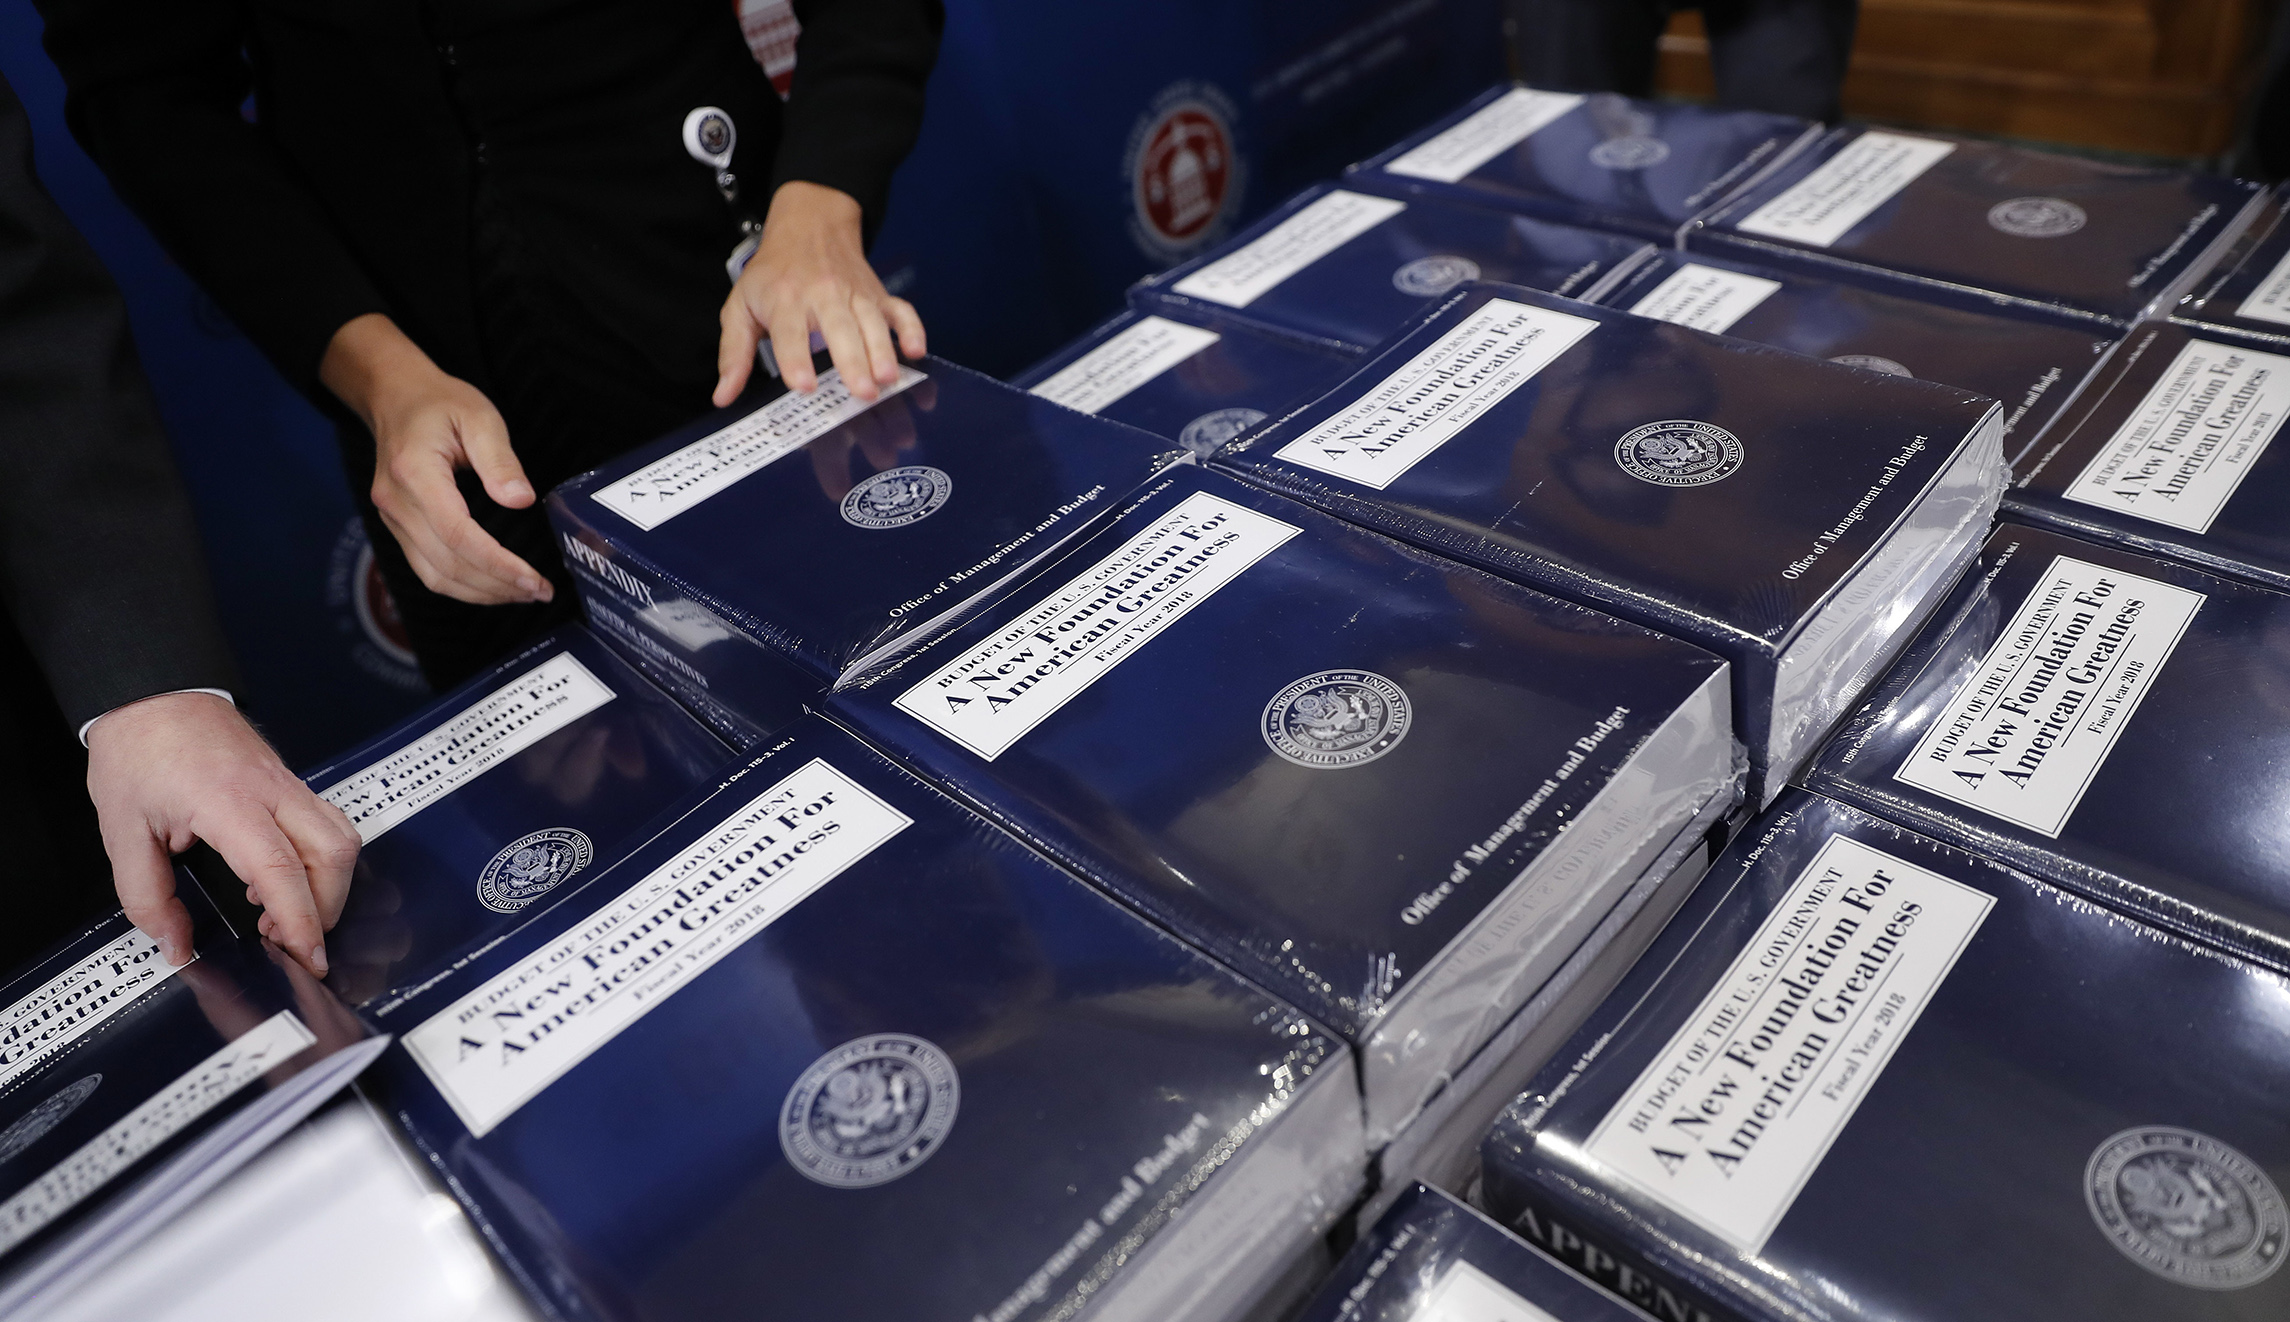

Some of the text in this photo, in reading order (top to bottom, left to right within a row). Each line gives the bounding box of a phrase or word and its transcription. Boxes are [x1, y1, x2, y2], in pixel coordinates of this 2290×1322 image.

[1321, 313, 1528, 461] A New Foundation For
[1360, 327, 1546, 460] American Greatness
[1693, 423, 1727, 442] UNITED
[1723, 439, 1738, 463] STATES
[629, 491, 648, 503] A
[1626, 462, 1660, 481] OFFICE
[1658, 471, 1721, 485] EXECUTIVE
[1781, 432, 1928, 581] Office of Management and Budget
[562, 531, 660, 614] APPENDIX
[881, 652, 918, 677] Congress,
[918, 646, 928, 655] 1st
[927, 629, 957, 648] Session
[1124, 503, 1140, 514] Doc.
[889, 484, 1106, 619] Office of Management and Budget
[937, 641, 1005, 689] BUDGET
[1004, 625, 1025, 642] OF
[1024, 603, 1061, 626] THE
[1090, 512, 1189, 582] GOVERNMENT
[945, 512, 1228, 714] A New Foundation For
[986, 531, 1239, 714] American Greatness
[1092, 590, 1192, 661] Fiscal Year 2018
[1842, 747, 1859, 764] 115th
[1988, 566, 2002, 577] Doc.
[2005, 544, 2018, 557] Vol.
[1929, 712, 1975, 763] BUDGET
[1966, 695, 1987, 713] OF
[1977, 672, 2006, 696] THE
[2013, 578, 2072, 650] GOVERNMENT
[1951, 578, 2117, 790] A New Foundation For
[375, 675, 570, 788] Foundation For
[447, 694, 568, 764] Greatness
[1270, 674, 1408, 765] EXECUTIVE OFFICE PRESIDENT UNITED STATES
[1998, 598, 2145, 790] American Greatness
[2086, 660, 2145, 735] Fiscal Year 2018
[719, 782, 731, 790] H.
[729, 769, 750, 783] Doc.
[748, 752, 774, 770] 115-3,
[772, 740, 791, 753] Vol.
[1401, 705, 1631, 925] Office of Management and Budget
[457, 962, 545, 1023] BUDGET
[549, 941, 575, 962] OF
[578, 912, 624, 942] THE
[667, 787, 793, 882] GOVERNMENT
[498, 831, 552, 863] PRESIDENT
[571, 834, 588, 857] UNITED
[1742, 860, 1755, 869] H.
[1749, 846, 1766, 860] Doc.
[1760, 827, 1781, 847] 115-3,
[1775, 815, 1791, 829] Vol.
[14, 937, 136, 1018] GOVERNMENT
[458, 790, 835, 1061] A New Foundation For
[503, 820, 841, 1065] American Greatness
[632, 901, 766, 998] Fiscal Year 2018
[0, 978, 104, 1046] dation
[1631, 1059, 1693, 1131] BUDGET
[1686, 1036, 1710, 1060] OF
[1702, 1003, 1739, 1037] THE
[1757, 866, 1842, 970] GOVERNMENT
[1651, 868, 1893, 1176] A New Foundation For
[1705, 900, 1925, 1181] American Greatness
[1818, 992, 1905, 1103] Fiscal Year 2018
